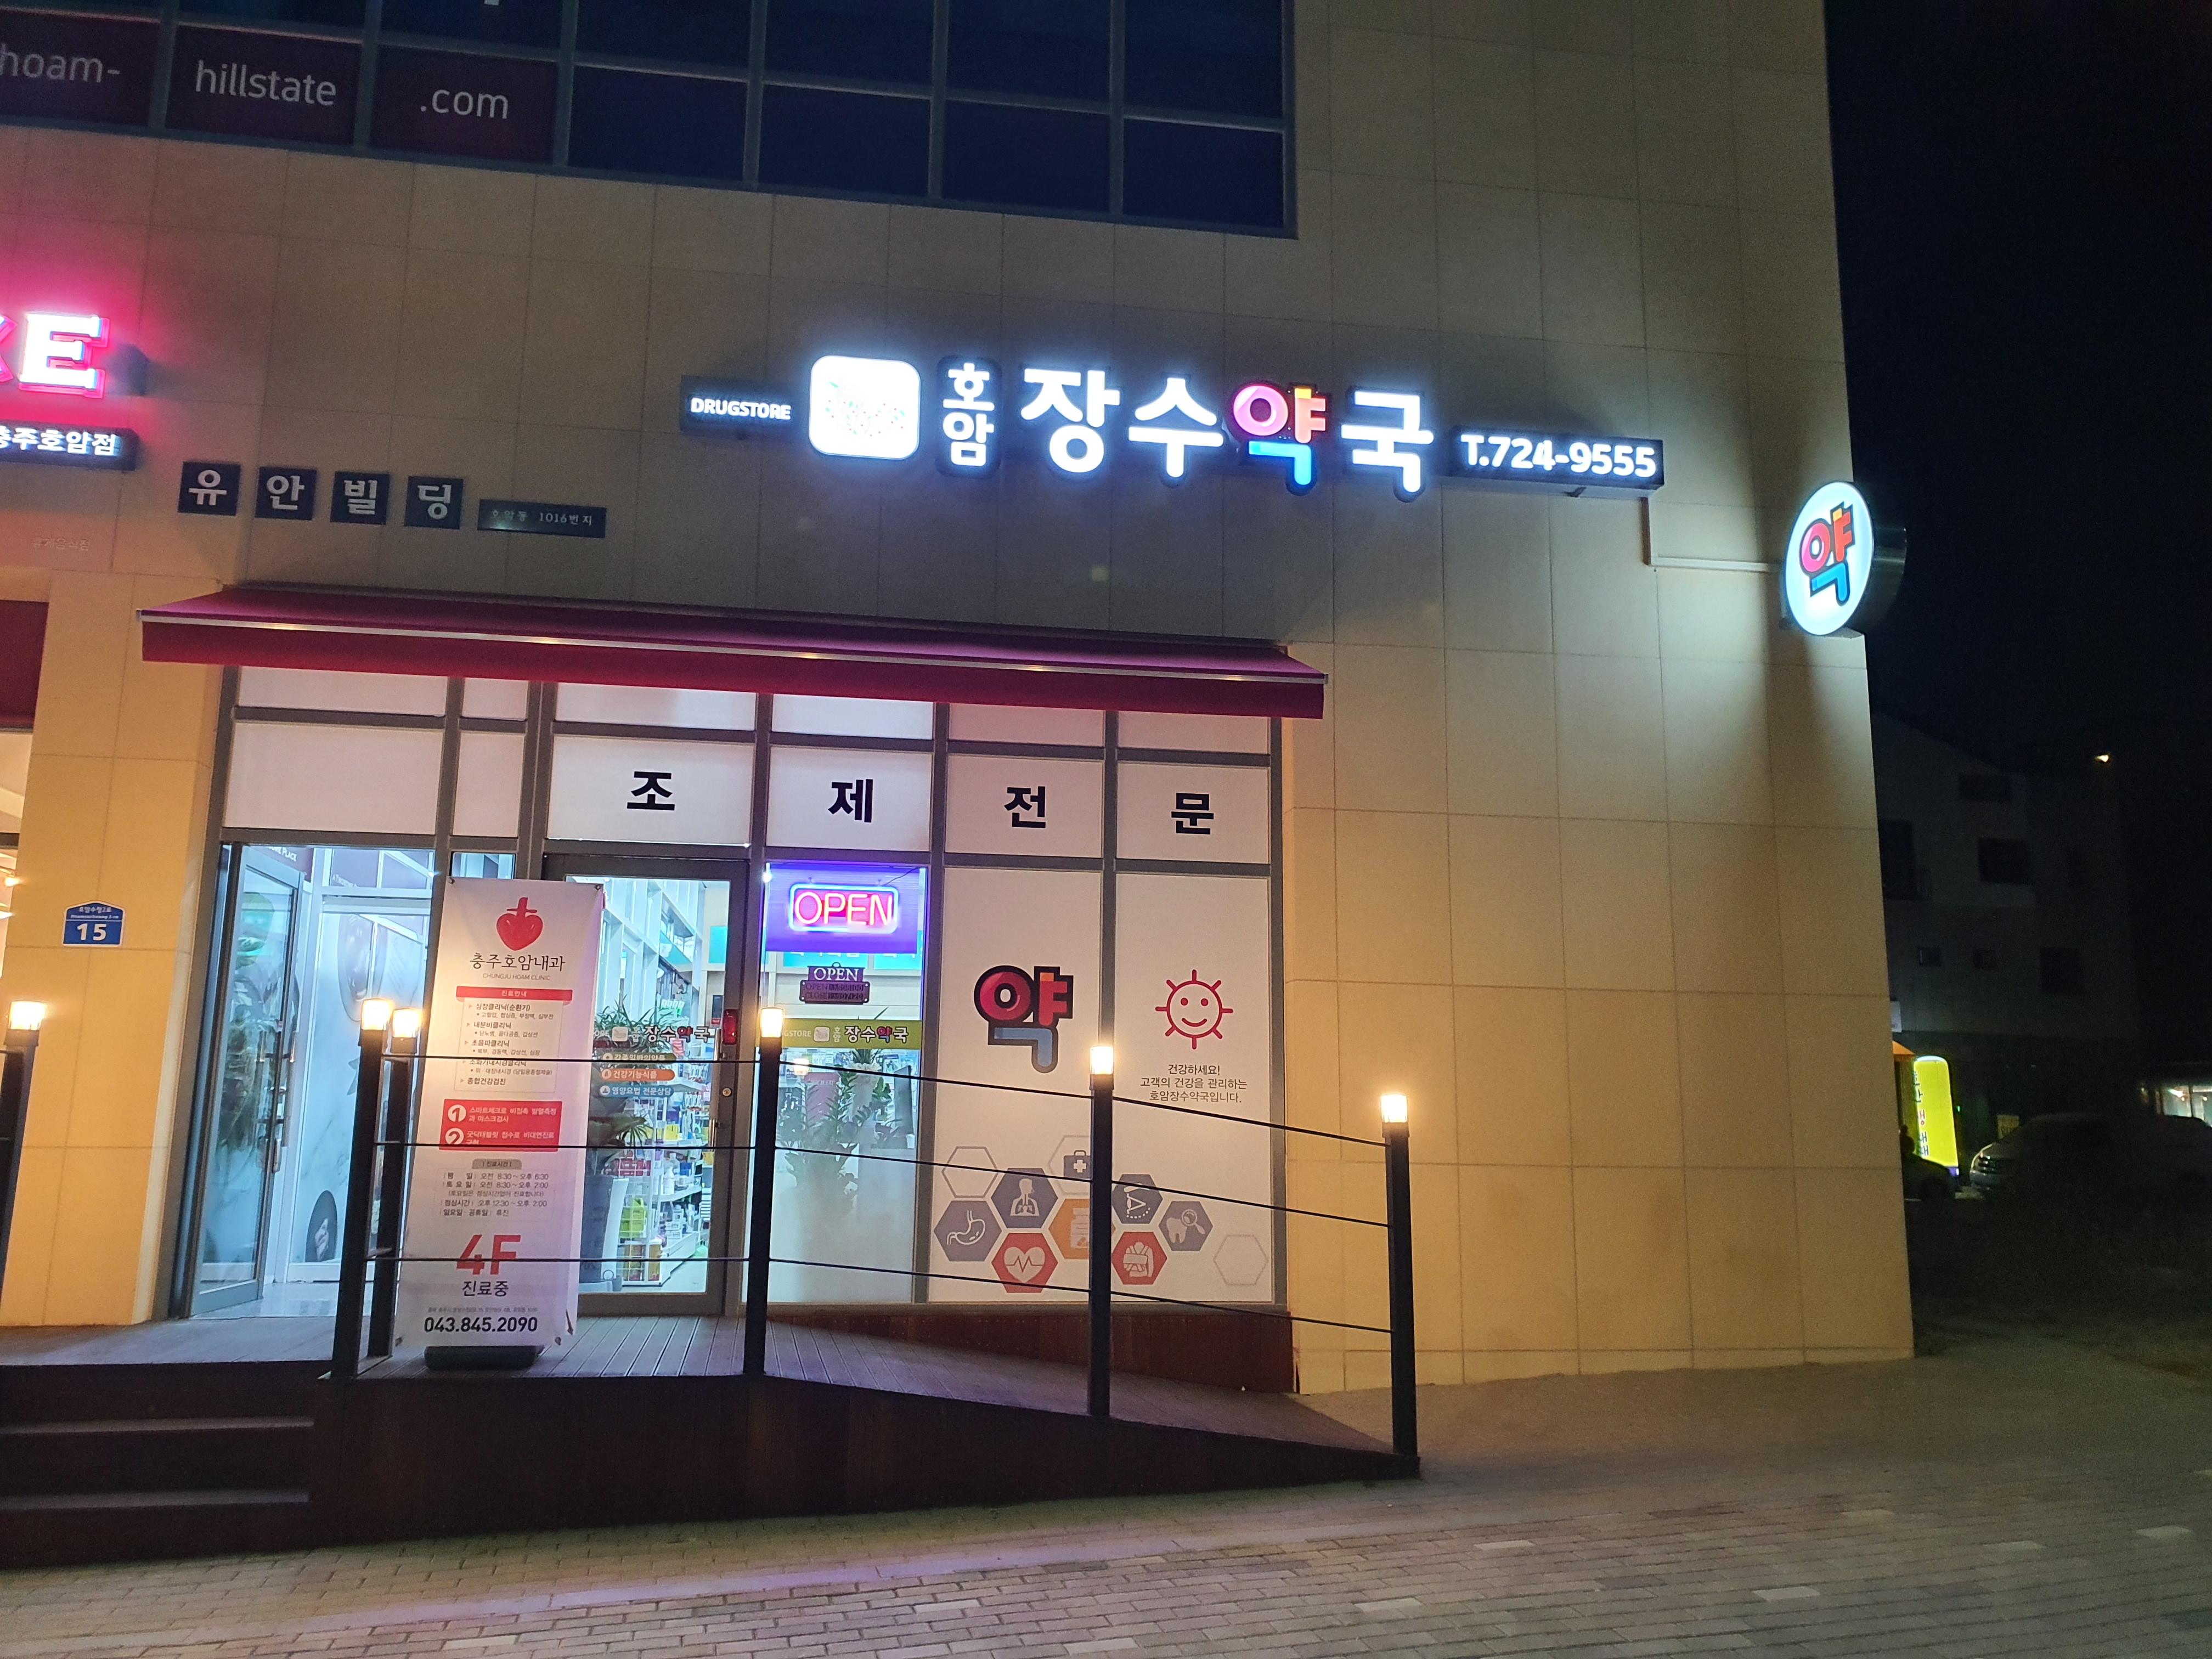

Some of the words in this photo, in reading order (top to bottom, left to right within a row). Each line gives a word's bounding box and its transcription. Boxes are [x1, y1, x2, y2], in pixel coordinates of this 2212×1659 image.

[195, 59, 336, 106] hillstate
[419, 88, 509, 120] .com
[690, 397, 792, 421] DRUGSTORE
[1020, 369, 1435, 494] 장수약국
[1459, 433, 1657, 478] T.724-9555
[1799, 501, 1856, 607] 약
[794, 890, 894, 927] OPEN
[77, 923, 107, 941] 15
[470, 952, 566, 972] 충주호암내과
[814, 967, 859, 982] OPEN
[476, 1003, 531, 1012] 심장클리닉(순환기)
[473, 1021, 512, 1029] 내분비클리닉
[973, 964, 1074, 1074] 약
[644, 1025, 710, 1043] 장수약국
[783, 1029, 812, 1037] GSTORE
[844, 1025, 909, 1043] 장수약국
[613, 1070, 657, 1079] 건강기능식품
[1167, 1064, 1221, 1076] 건강하세요!
[467, 1077, 506, 1086] 종합건강검진
[1140, 1077, 1170, 1088] 고객의
[1175, 1077, 1204, 1089] 건강을
[1207, 1079, 1248, 1090] 관리하는
[612, 1086, 641, 1096] 영양요법
[643, 1087, 672, 1096] 전문상담
[1149, 1090, 1242, 1103] 호암장수약국입니다.
[456, 1234, 521, 1275] 4F
[461, 1280, 509, 1297] 진료중
[424, 1317, 538, 1333] 043.845.2090
